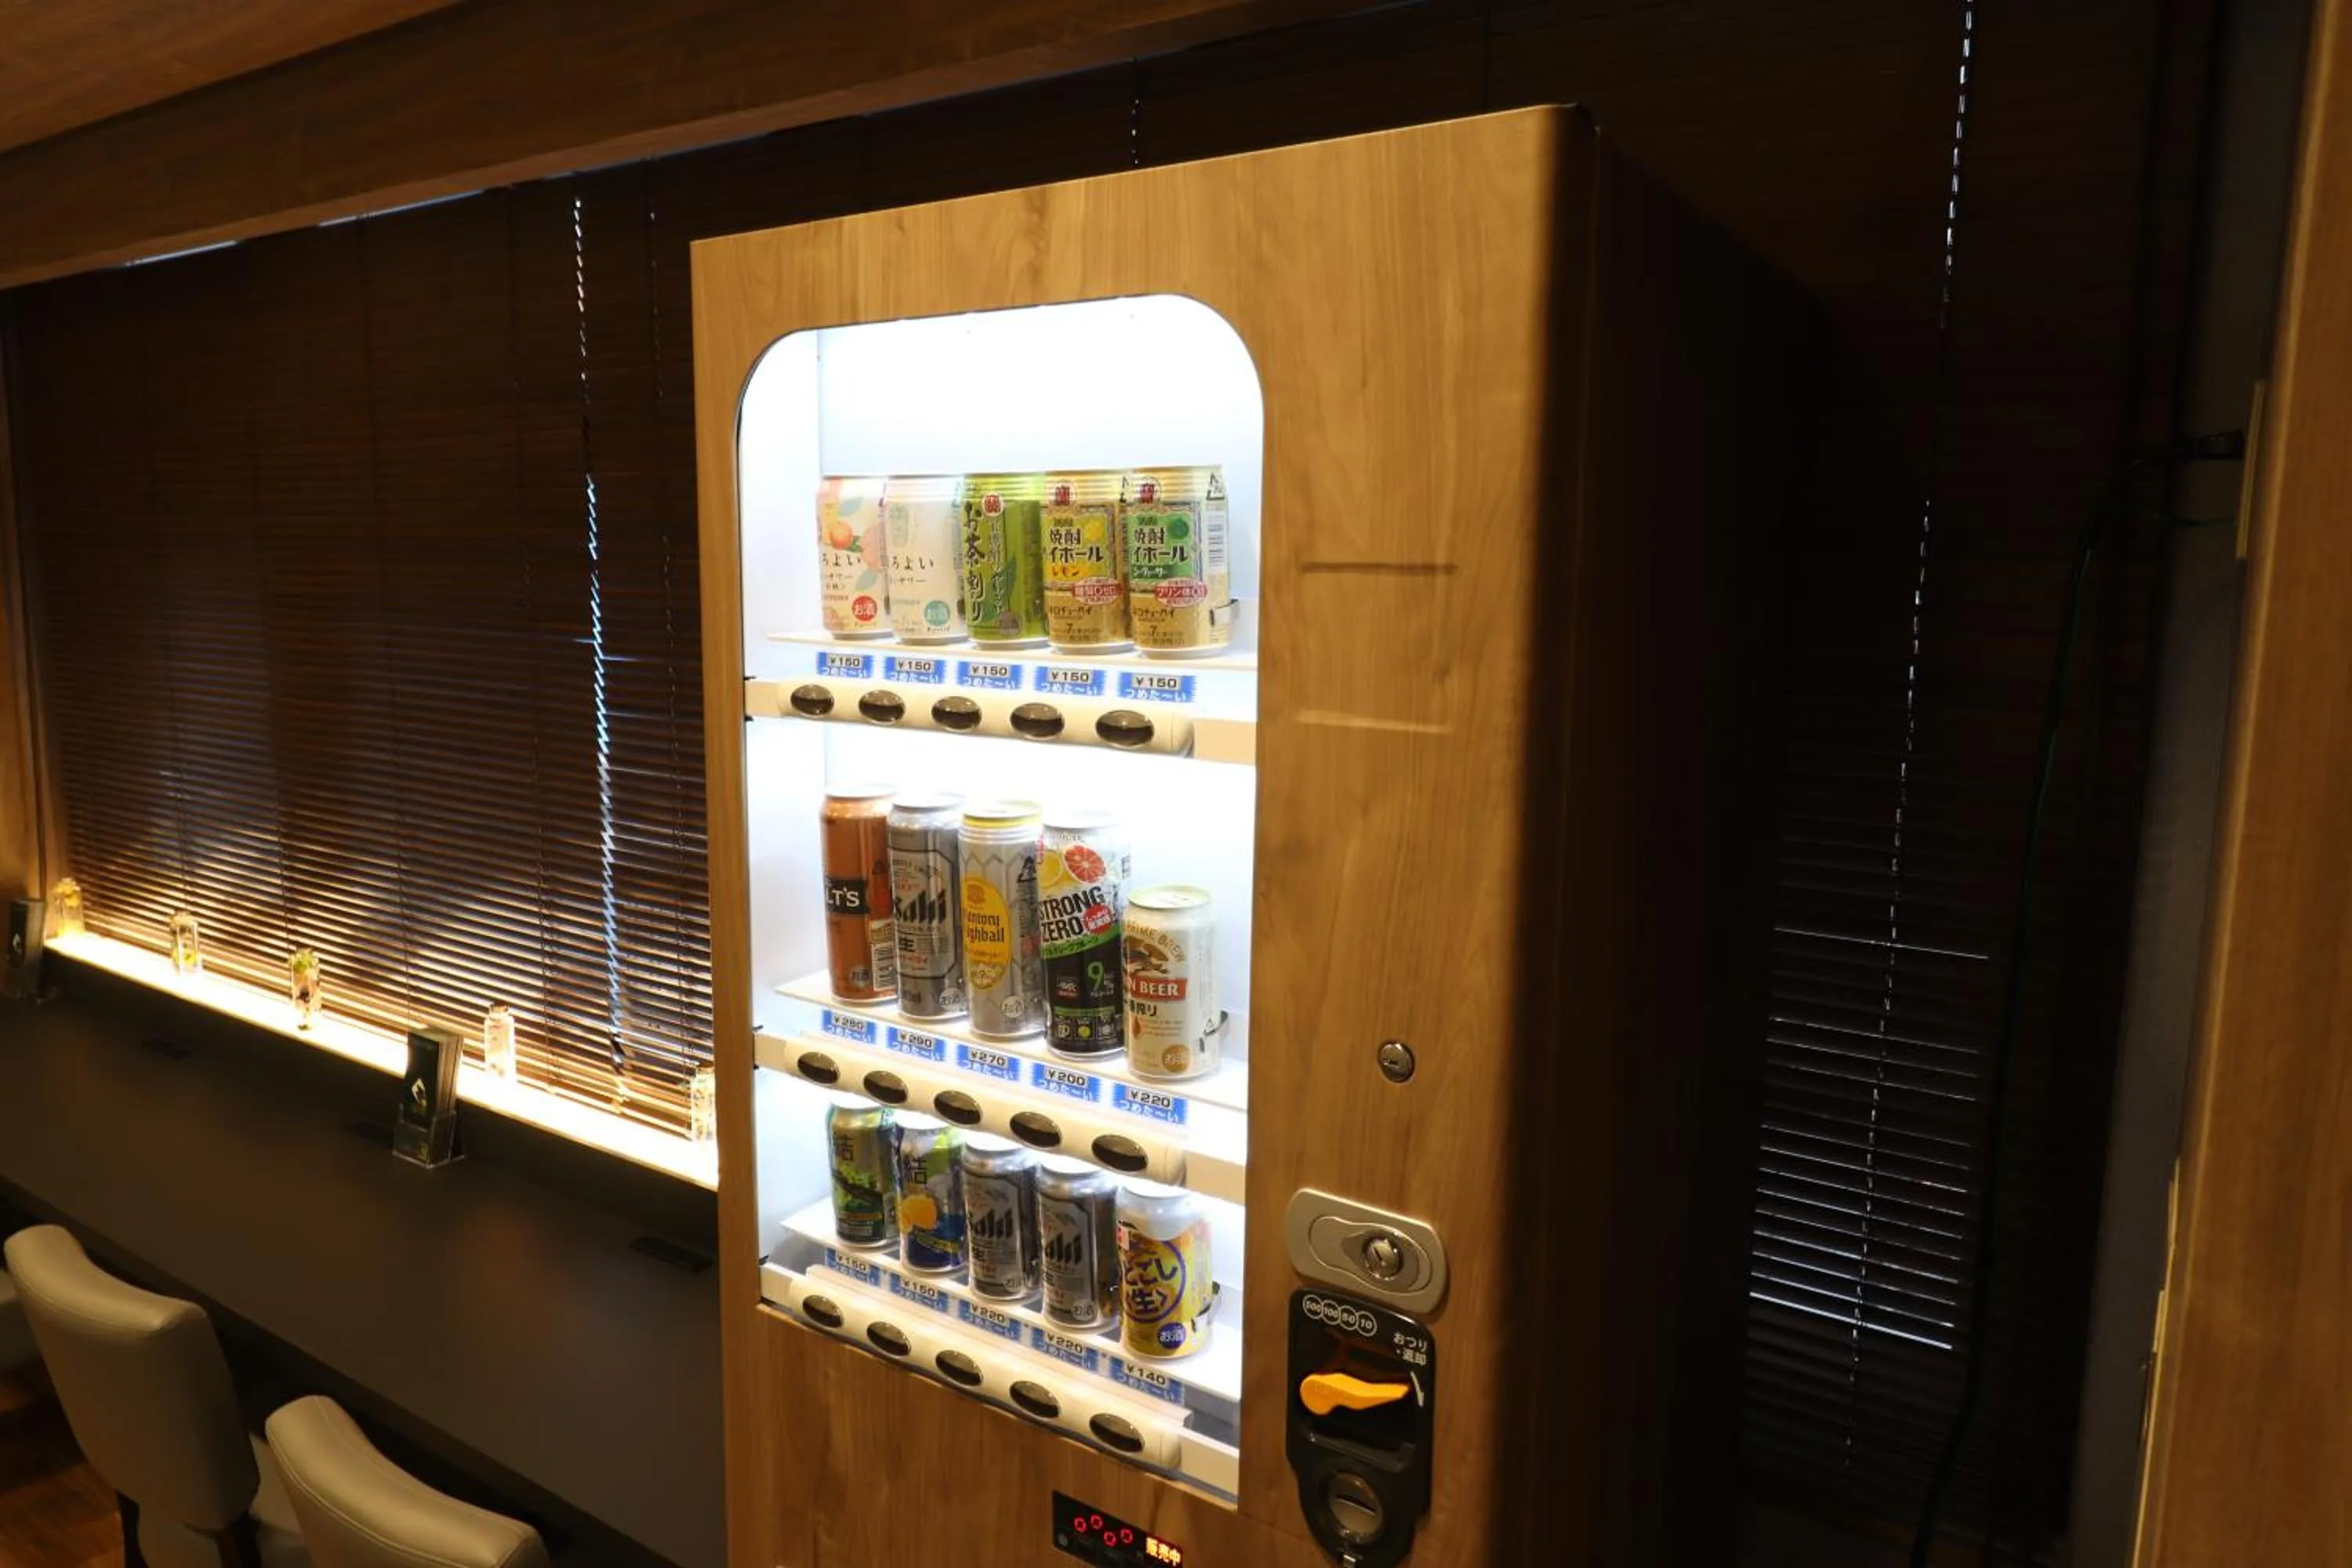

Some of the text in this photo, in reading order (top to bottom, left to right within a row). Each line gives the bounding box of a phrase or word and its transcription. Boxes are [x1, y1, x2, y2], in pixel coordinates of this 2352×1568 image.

[823, 554, 861, 567] ろよい
[1049, 546, 1104, 562] イホール
[1134, 545, 1188, 562] イホール
[893, 556, 934, 570] ろよい
[971, 666, 1007, 677] ¥150
[825, 887, 859, 906] LT'S
[967, 927, 1004, 942] ighball
[1041, 916, 1083, 942] ZERO
[1139, 980, 1179, 996] BEER
[1048, 1069, 1085, 1087] ¥200
[1131, 1091, 1171, 1108] ¥220
[903, 1156, 927, 1184] 結
[1305, 1301, 1372, 1329] 500 100 50 10
[1394, 1332, 1427, 1352] おつり
[1127, 1364, 1167, 1385] ¥140
